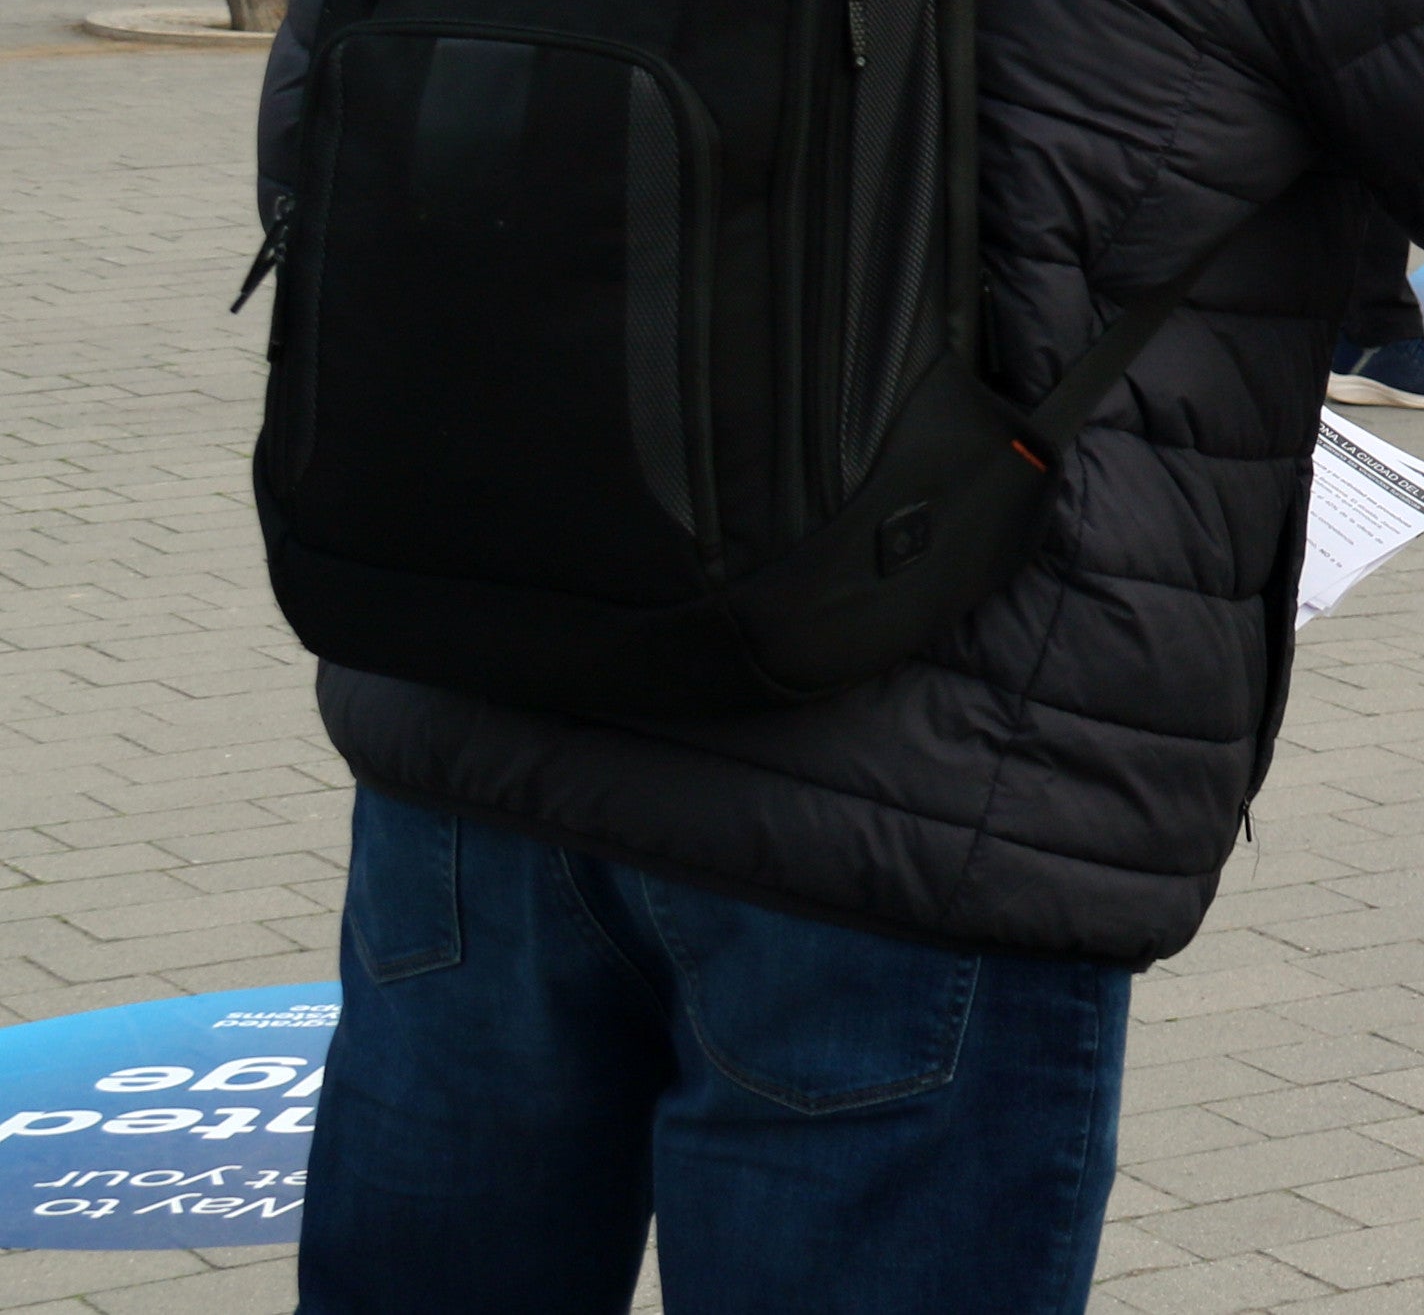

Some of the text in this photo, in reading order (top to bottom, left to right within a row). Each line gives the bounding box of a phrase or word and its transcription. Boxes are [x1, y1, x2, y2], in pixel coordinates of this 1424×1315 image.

[1342, 441, 1356, 453] LA
[1357, 452, 1397, 481] CIUDAD
[1398, 480, 1420, 495] DEL
[33, 1165, 243, 1188] your
[33, 1198, 120, 1219] to
